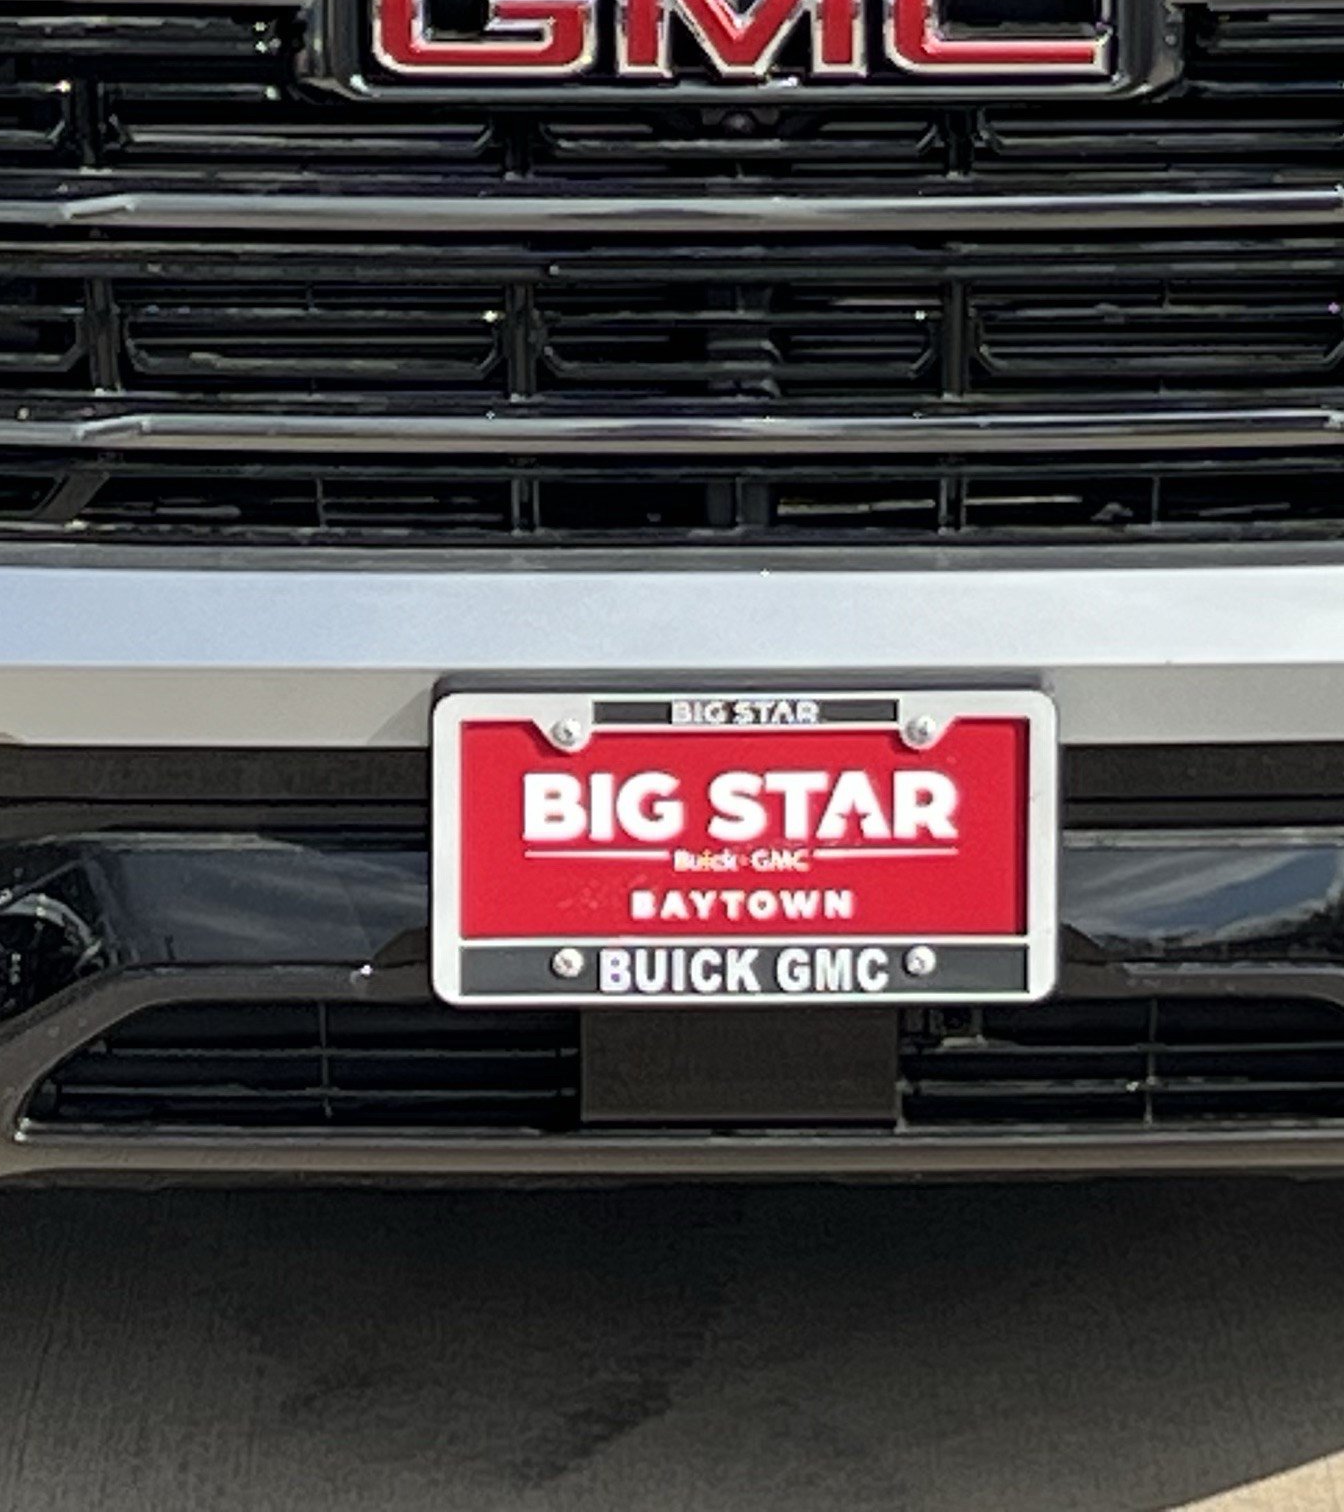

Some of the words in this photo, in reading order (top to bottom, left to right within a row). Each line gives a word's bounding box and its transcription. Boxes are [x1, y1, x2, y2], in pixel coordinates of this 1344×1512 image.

[671, 700, 727, 724] BIG
[734, 700, 820, 724] STAR
[523, 771, 685, 842] BIG
[708, 771, 959, 841] STAR
[673, 849, 738, 872] Buick
[750, 848, 811, 872] GMC
[630, 889, 854, 920] BAYTOWN
[599, 948, 761, 992] BUICK
[776, 947, 889, 992] GMC
